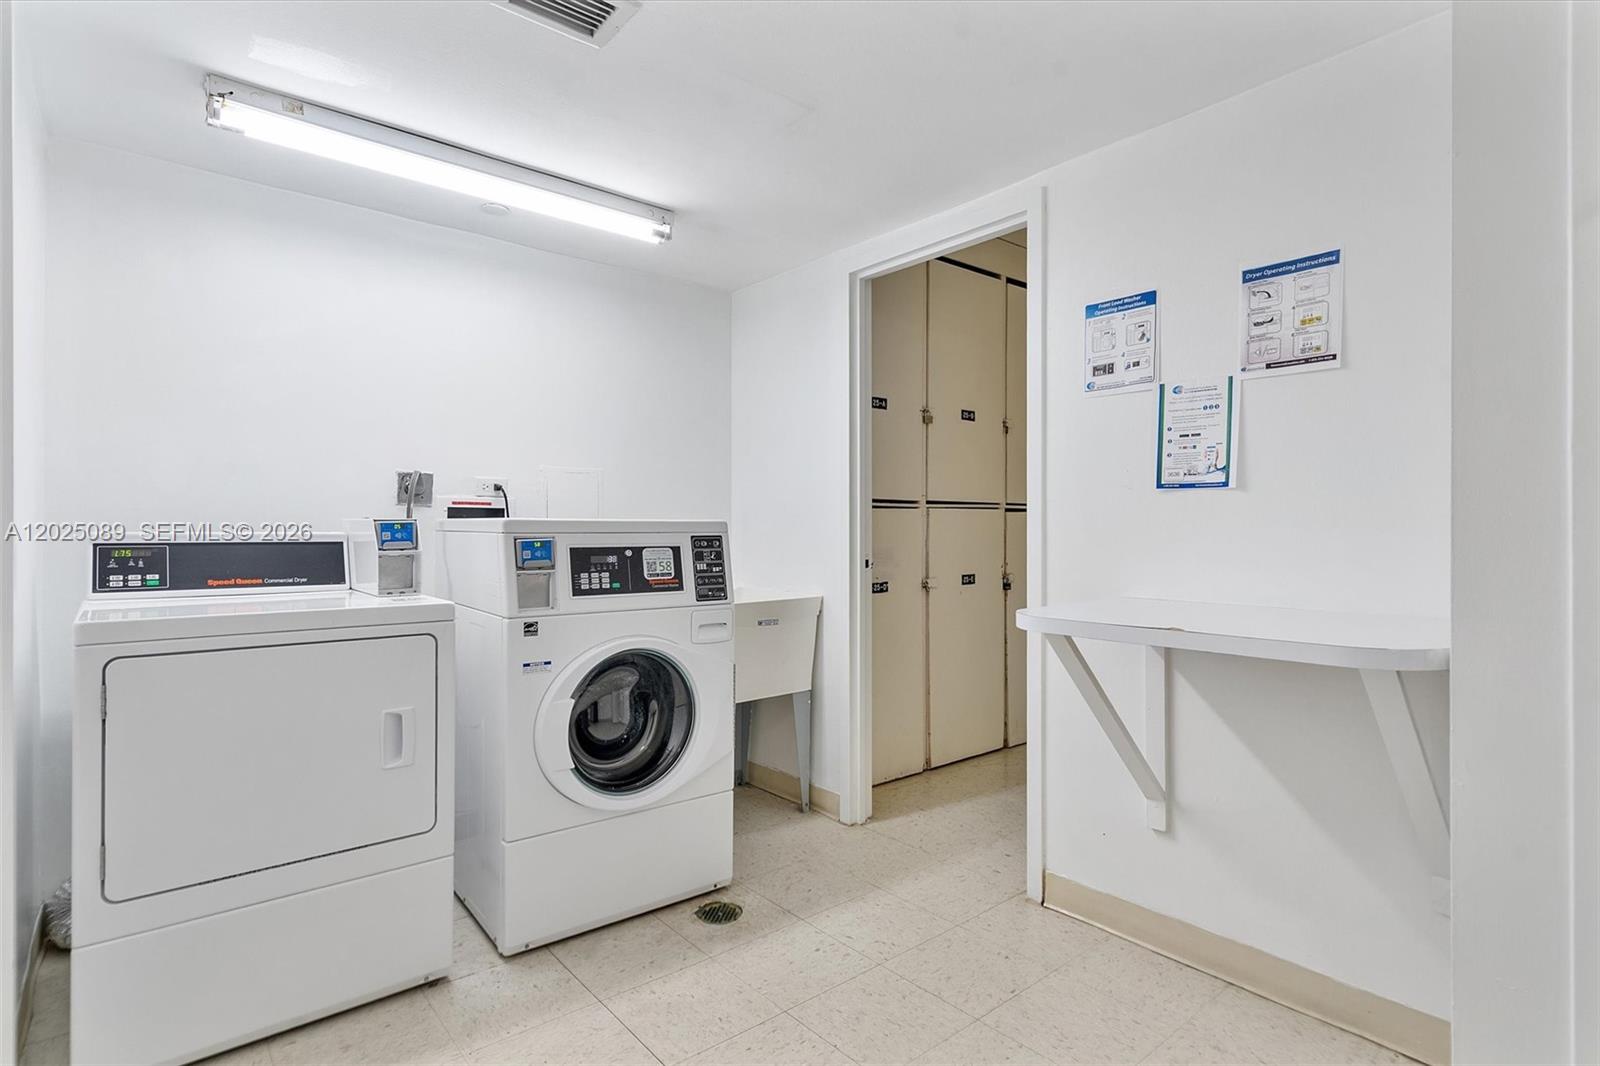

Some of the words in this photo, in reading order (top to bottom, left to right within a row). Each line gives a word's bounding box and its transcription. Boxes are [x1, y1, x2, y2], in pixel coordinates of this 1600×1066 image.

[1245, 272, 1263, 280] Dryer
[1263, 264, 1296, 276] Operating
[1296, 255, 1336, 269] Instructions
[1094, 306, 1117, 316] Operating
[1118, 300, 1147, 310] Instructions
[872, 398, 886, 408] 25-A
[658, 561, 672, 572] 58
[207, 579, 235, 587] Speed
